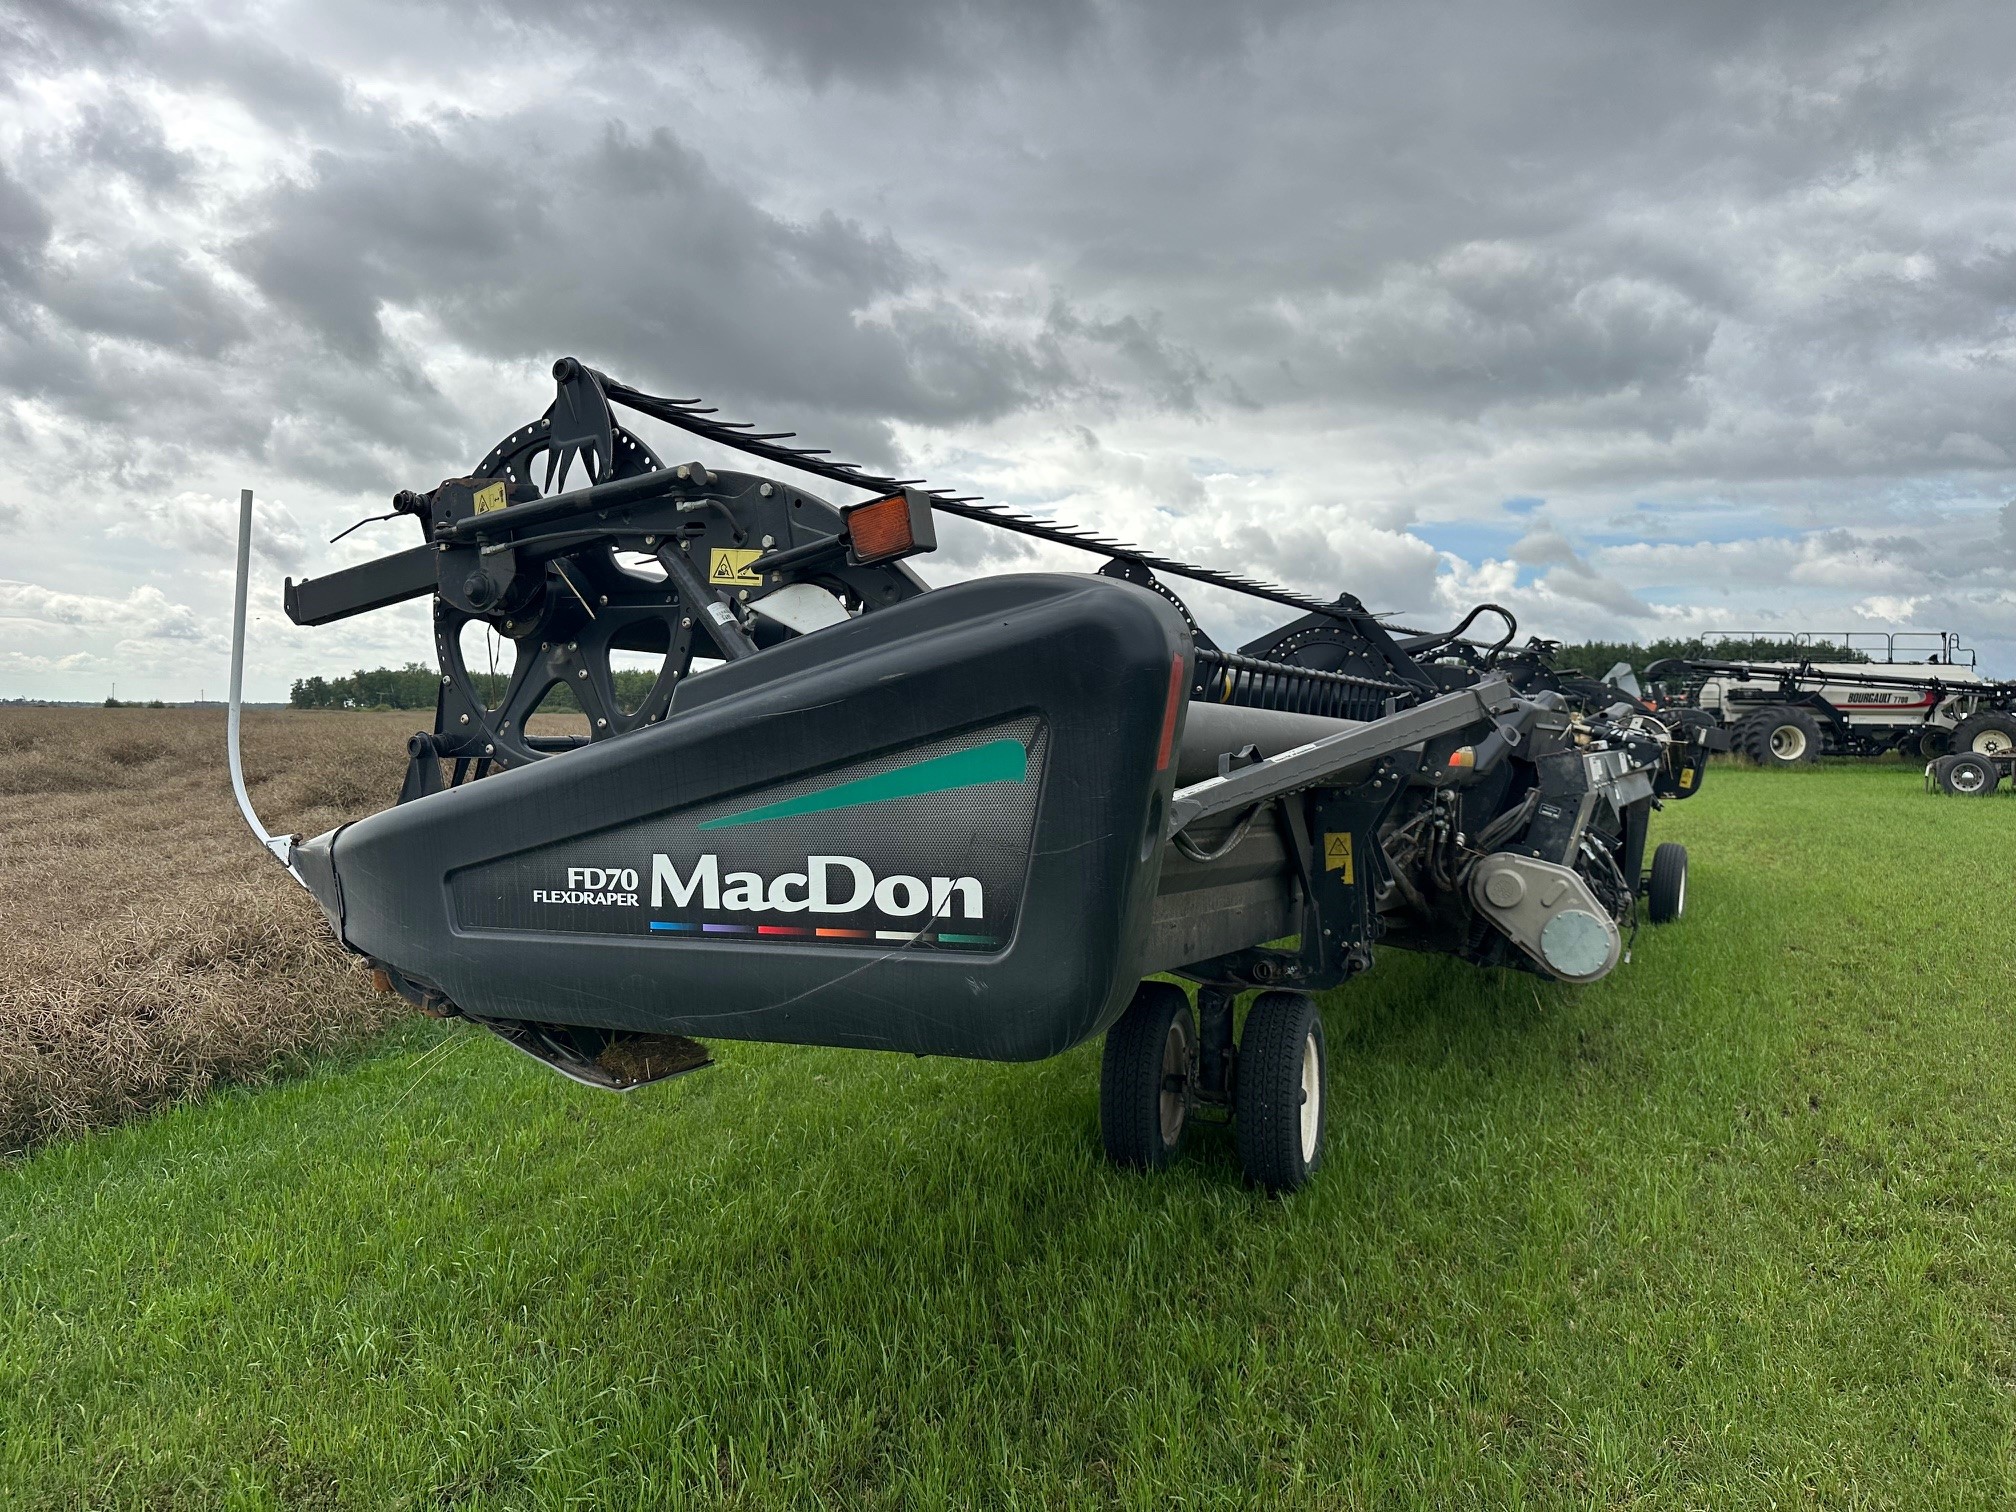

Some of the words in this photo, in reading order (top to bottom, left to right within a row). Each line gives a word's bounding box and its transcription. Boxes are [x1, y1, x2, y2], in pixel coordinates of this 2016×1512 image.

[1847, 692, 1892, 704] BOURGAULT
[567, 867, 639, 891] FD70
[650, 853, 984, 919] MacDon
[533, 890, 640, 907] FLEXDRAPER
